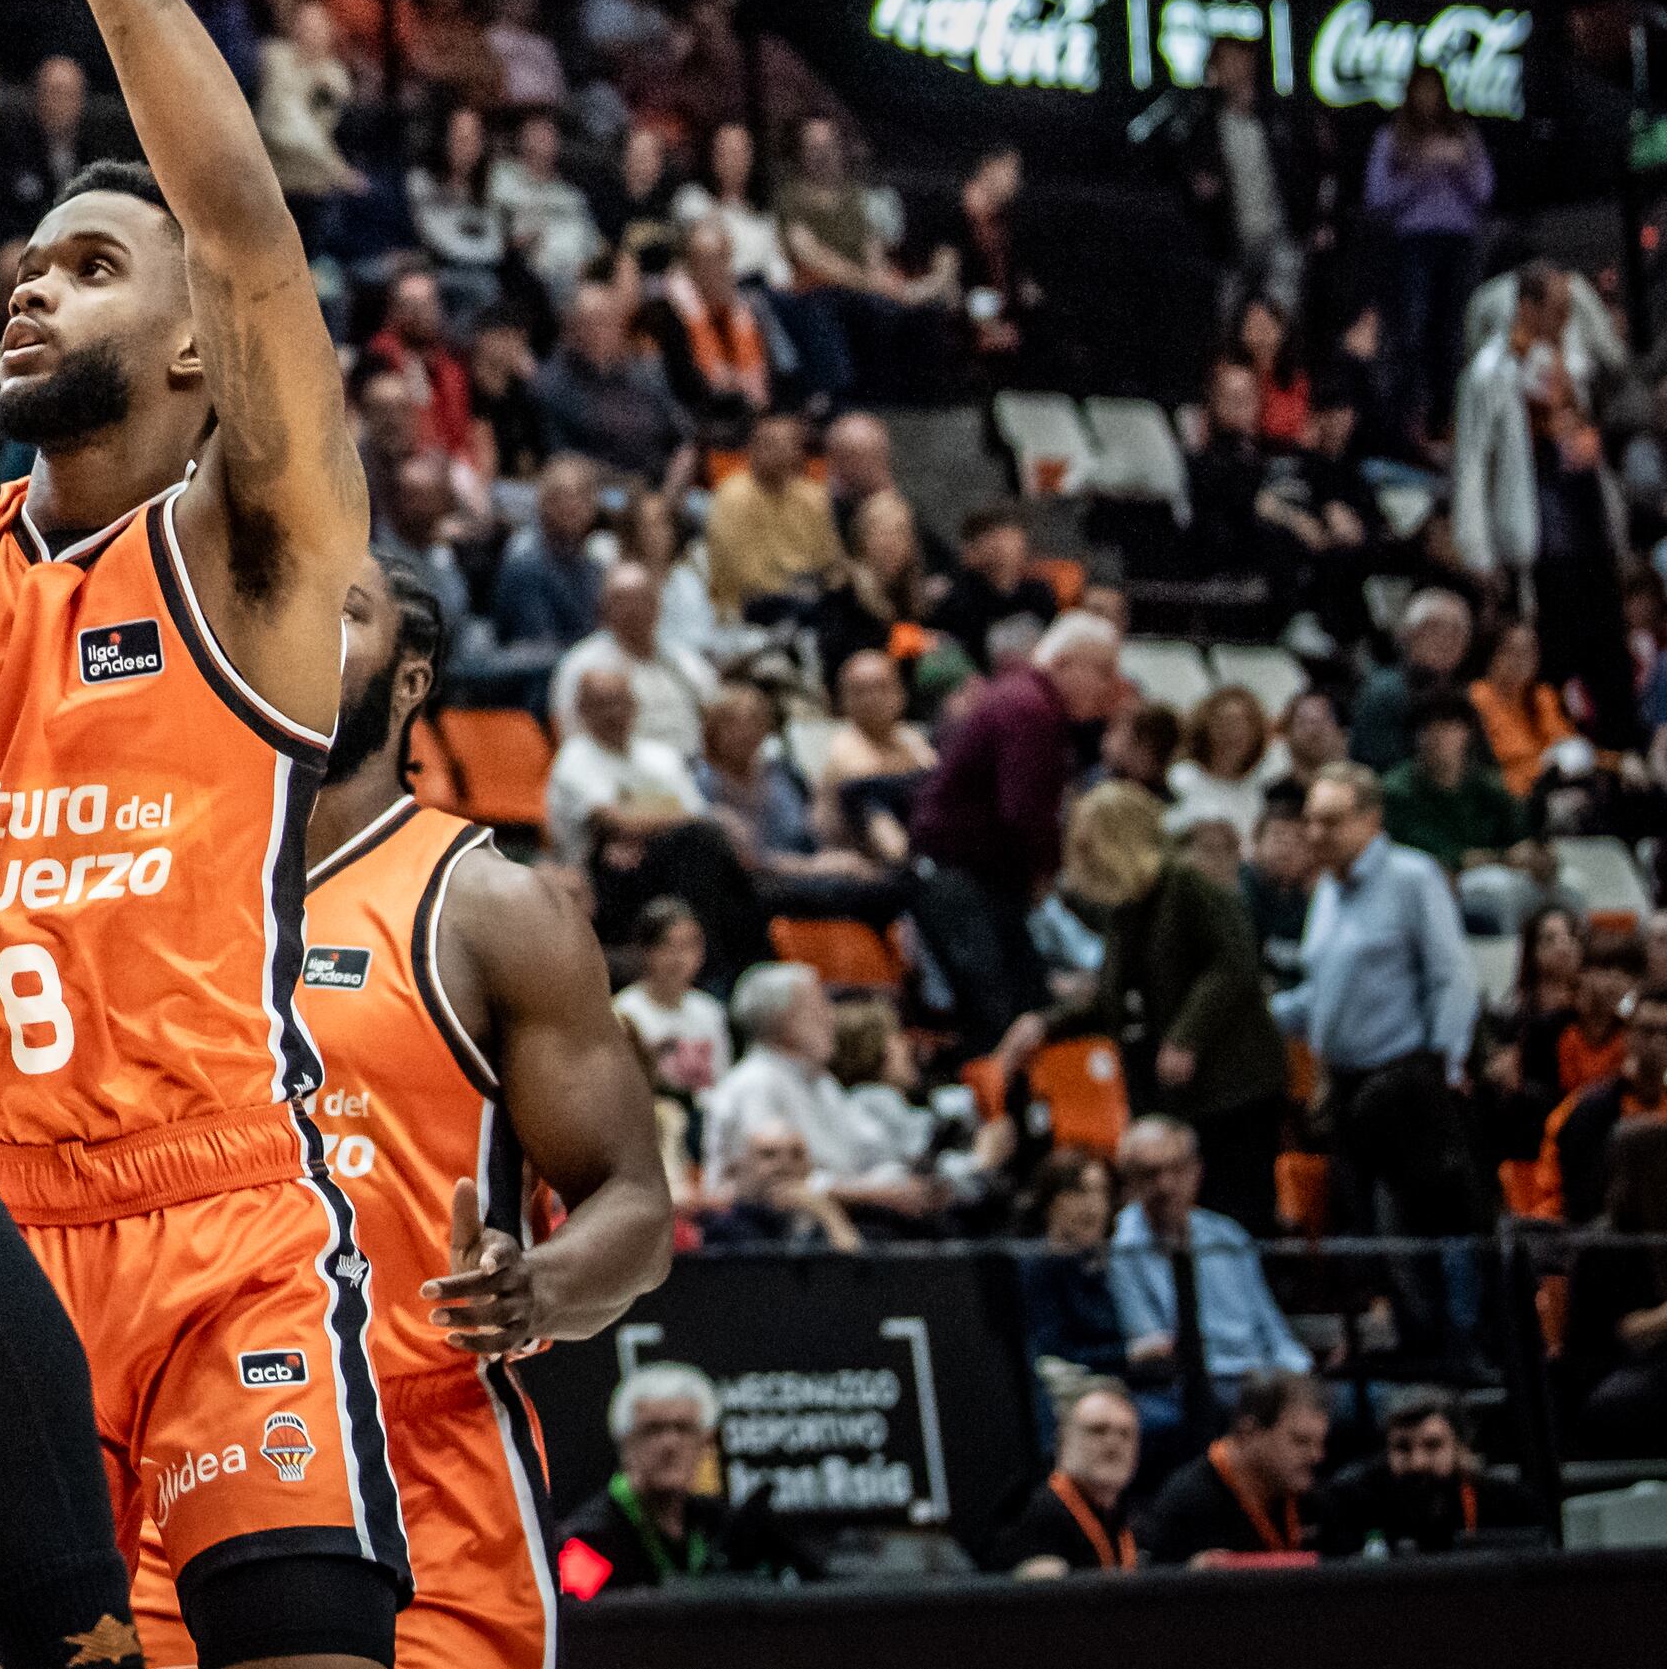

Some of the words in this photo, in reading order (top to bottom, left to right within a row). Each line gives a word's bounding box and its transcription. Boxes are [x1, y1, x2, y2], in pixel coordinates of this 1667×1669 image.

[87, 643, 119, 662] liga
[89, 654, 158, 677] endesa
[114, 792, 174, 831] del
[305, 970, 362, 985] endesa
[322, 1089, 371, 1118] del
[247, 1363, 293, 1383] acb
